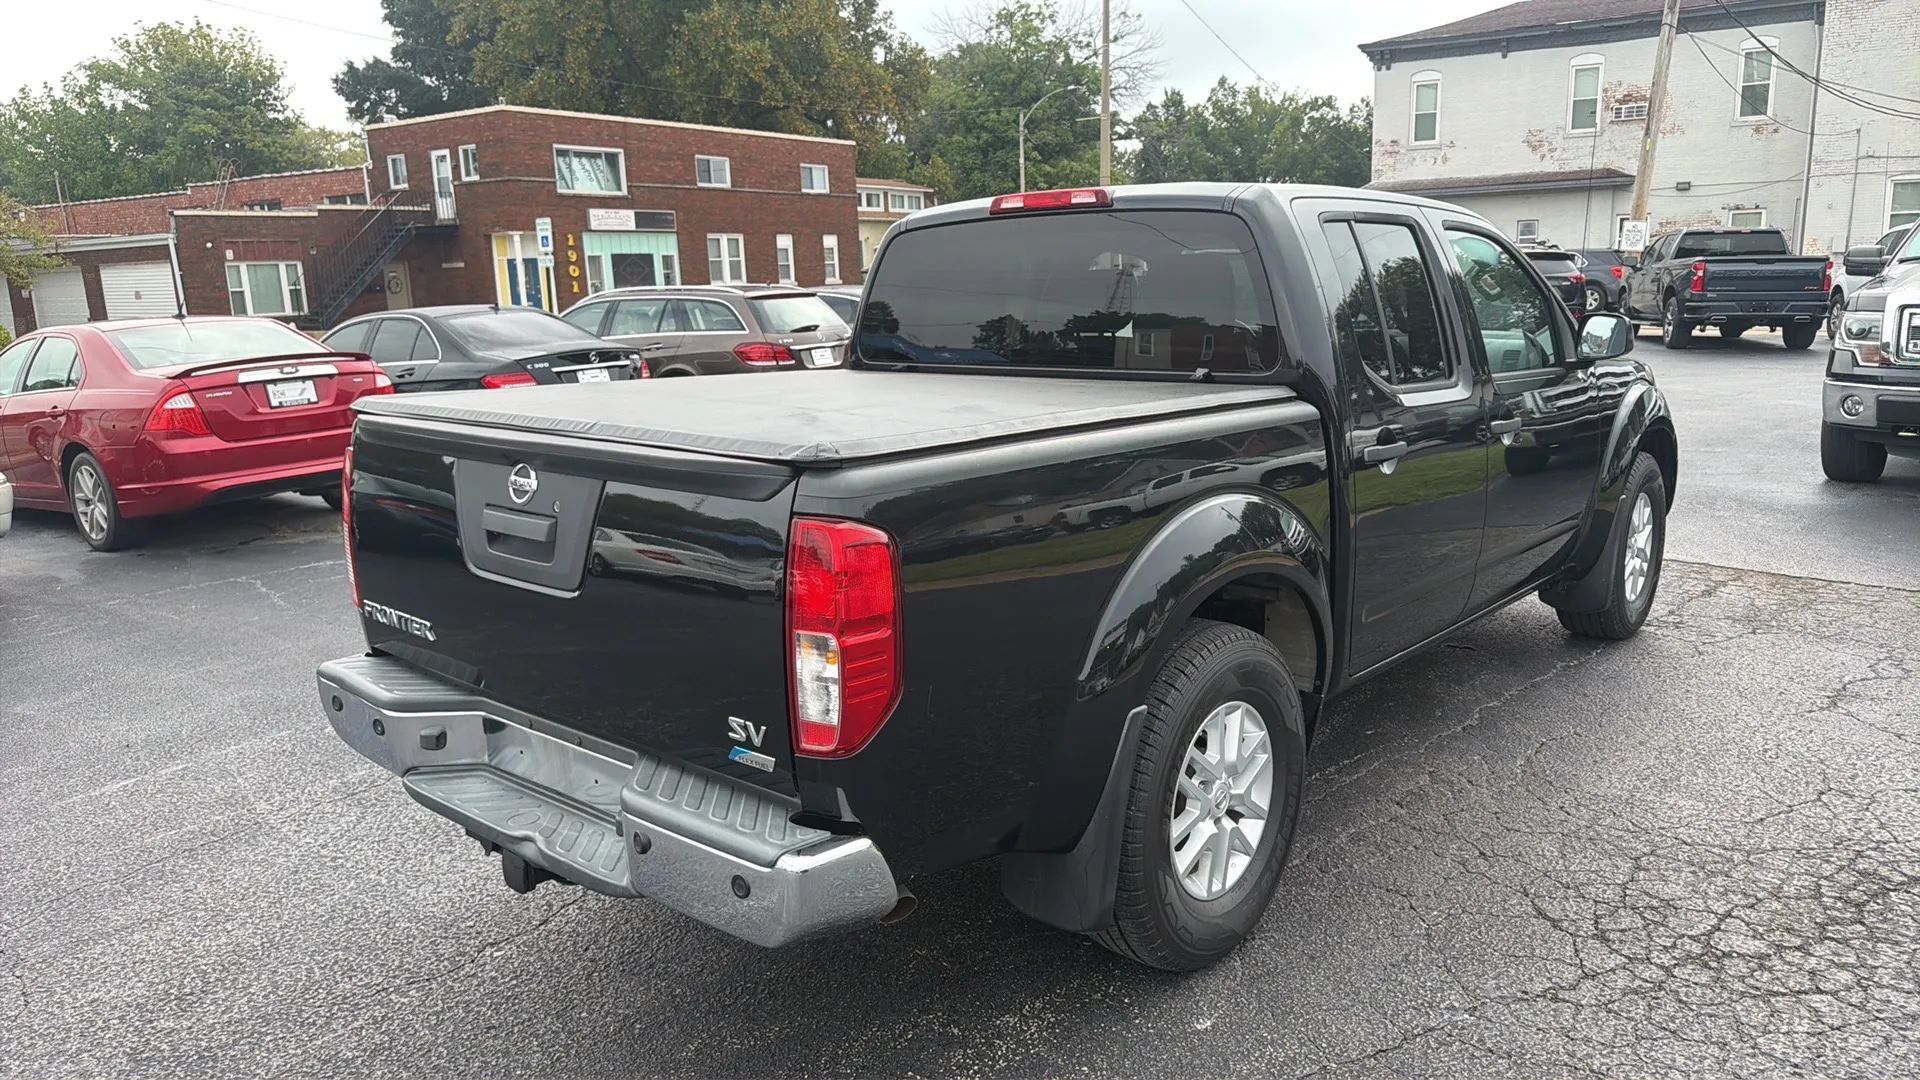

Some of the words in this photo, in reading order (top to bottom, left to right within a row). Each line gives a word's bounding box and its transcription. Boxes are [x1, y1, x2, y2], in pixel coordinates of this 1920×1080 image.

[567, 233, 580, 292] 1901
[363, 599, 437, 641] FRONTIER
[728, 716, 767, 748] SV
